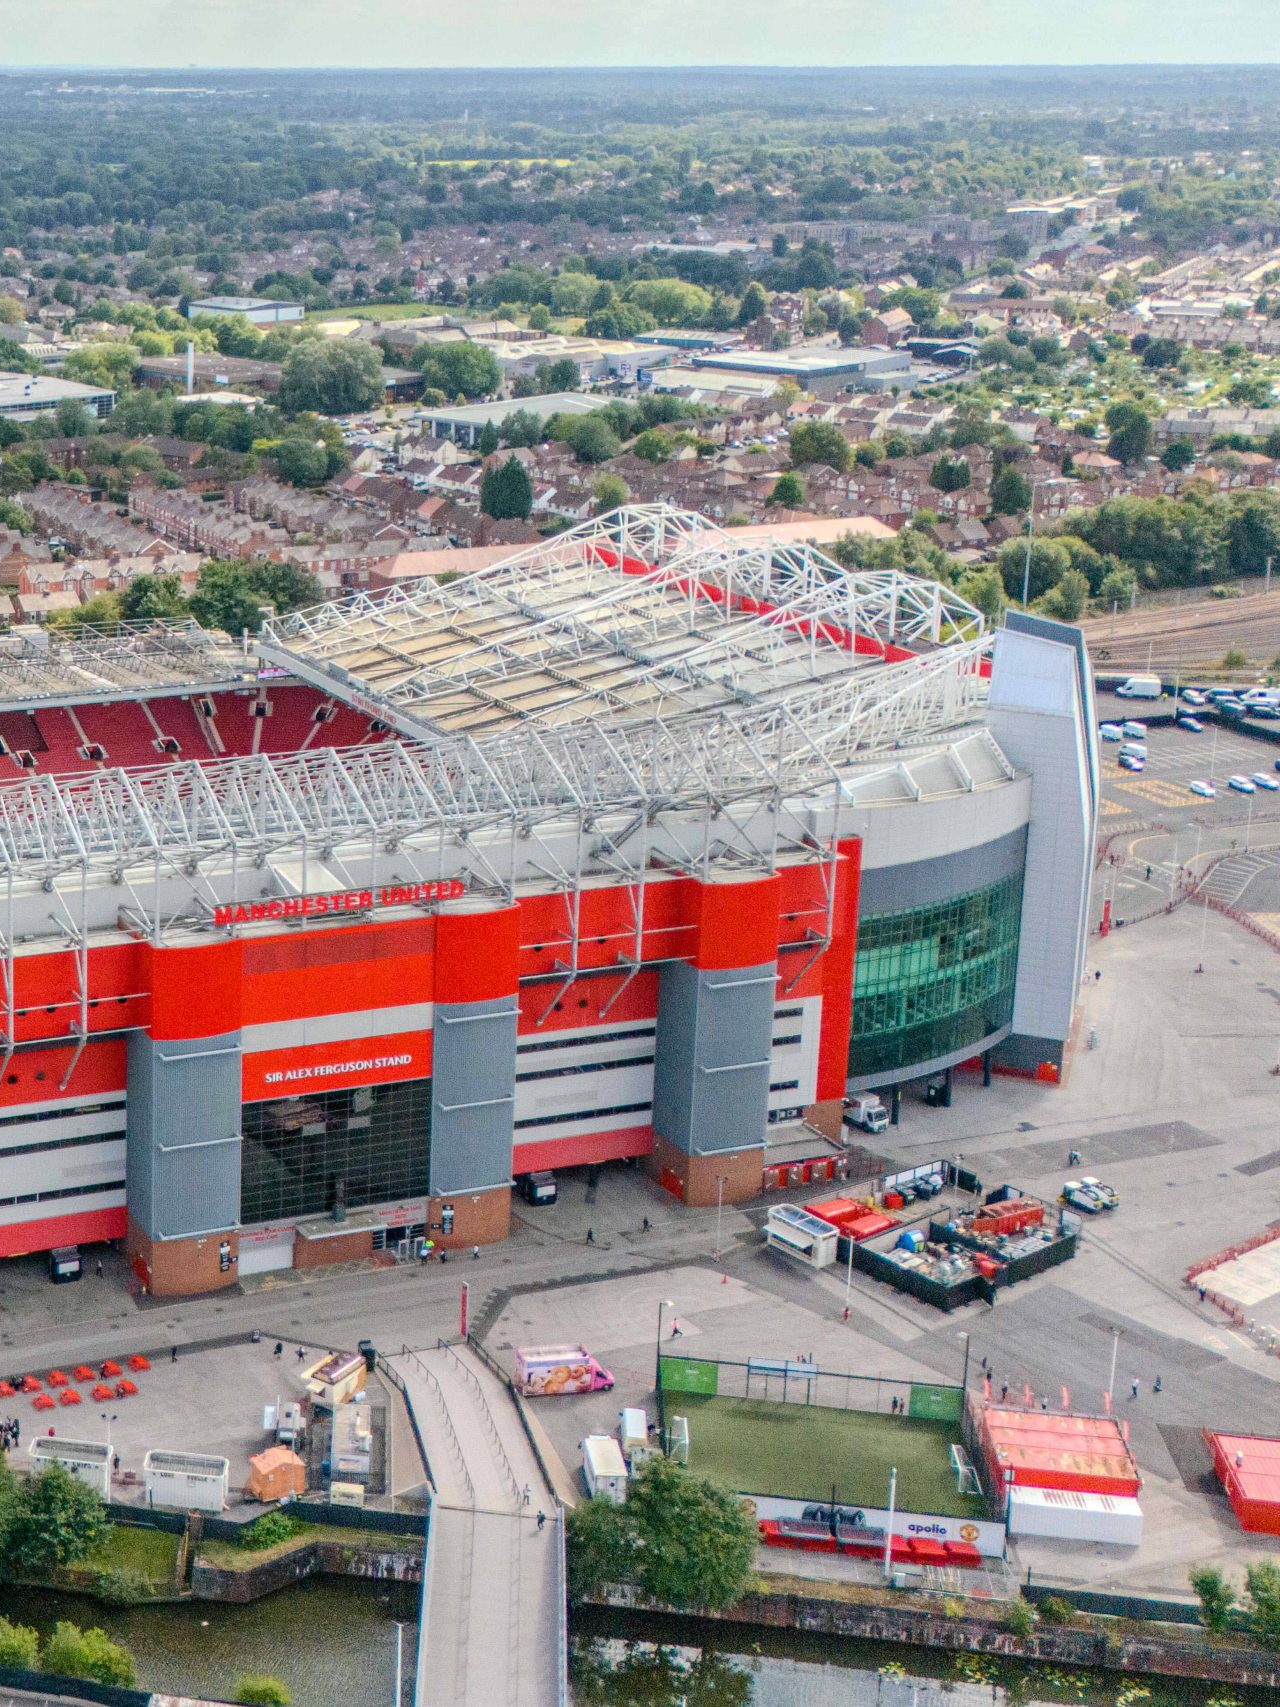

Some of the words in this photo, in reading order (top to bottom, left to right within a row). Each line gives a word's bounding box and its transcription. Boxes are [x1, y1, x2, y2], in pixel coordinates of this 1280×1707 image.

[214, 890, 373, 926] MANCHESTER
[381, 880, 465, 906] UNITED
[264, 1072, 283, 1083] SIR
[284, 1068, 312, 1081] ALEX
[313, 1059, 372, 1077] FERGUSON
[374, 1054, 412, 1069] STAND
